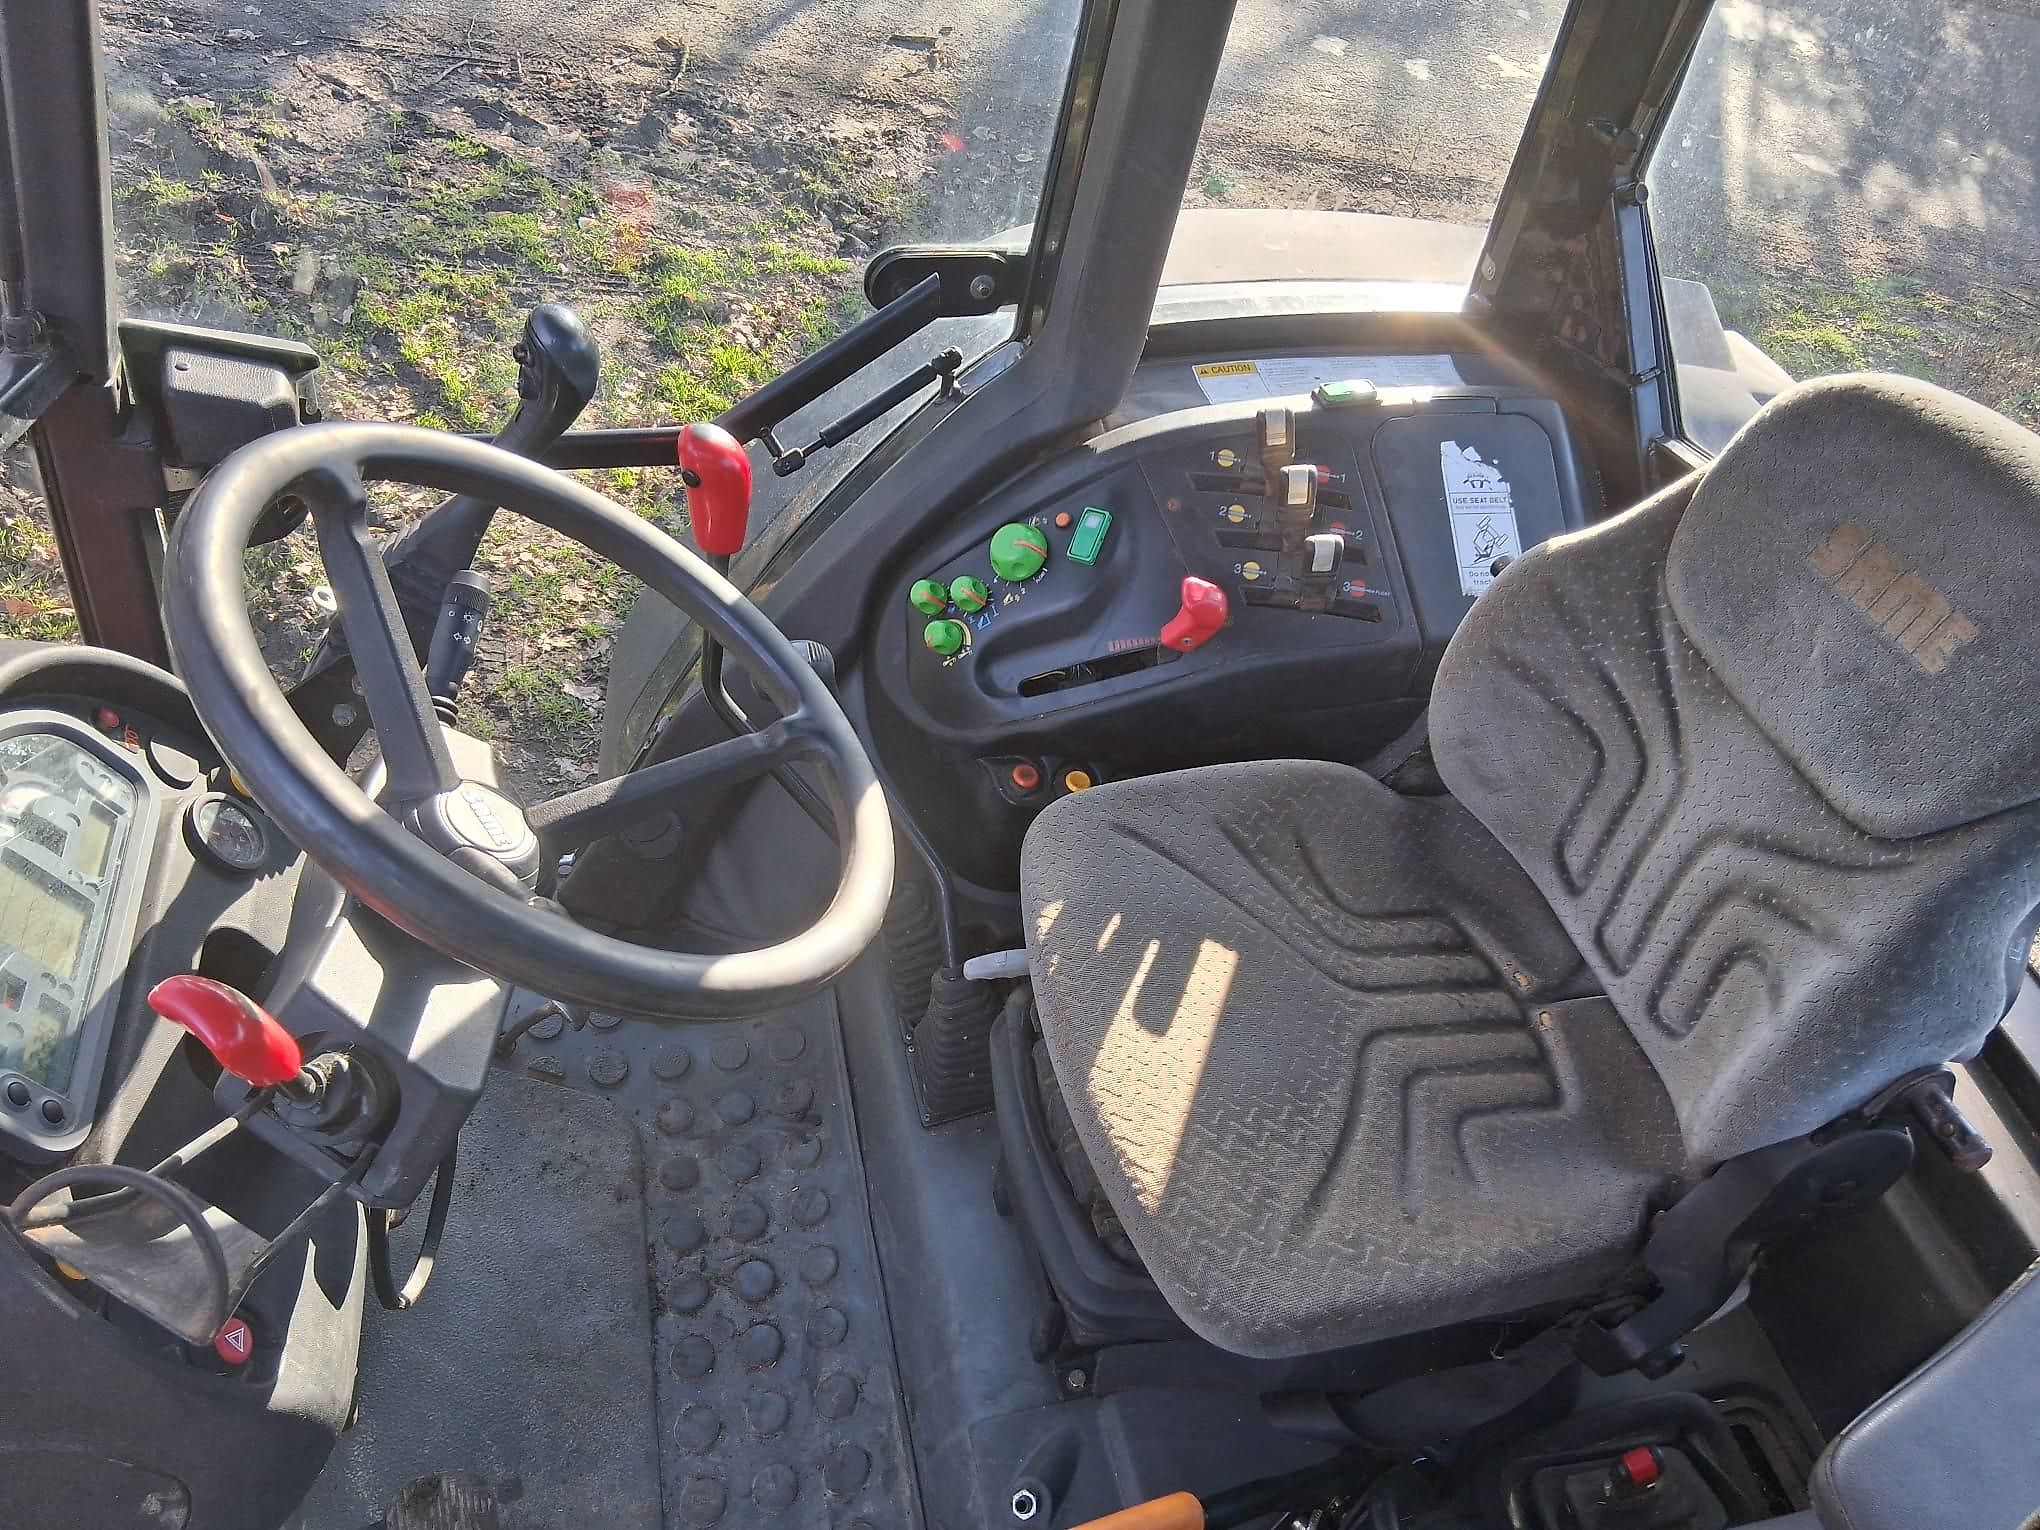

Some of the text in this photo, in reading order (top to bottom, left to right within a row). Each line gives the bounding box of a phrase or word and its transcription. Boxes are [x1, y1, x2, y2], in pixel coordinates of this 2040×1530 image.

[1211, 363, 1251, 374] CAUTION
[1219, 505, 1227, 516] 2
[1355, 530, 1363, 540] 2
[1233, 563, 1241, 574] 3
